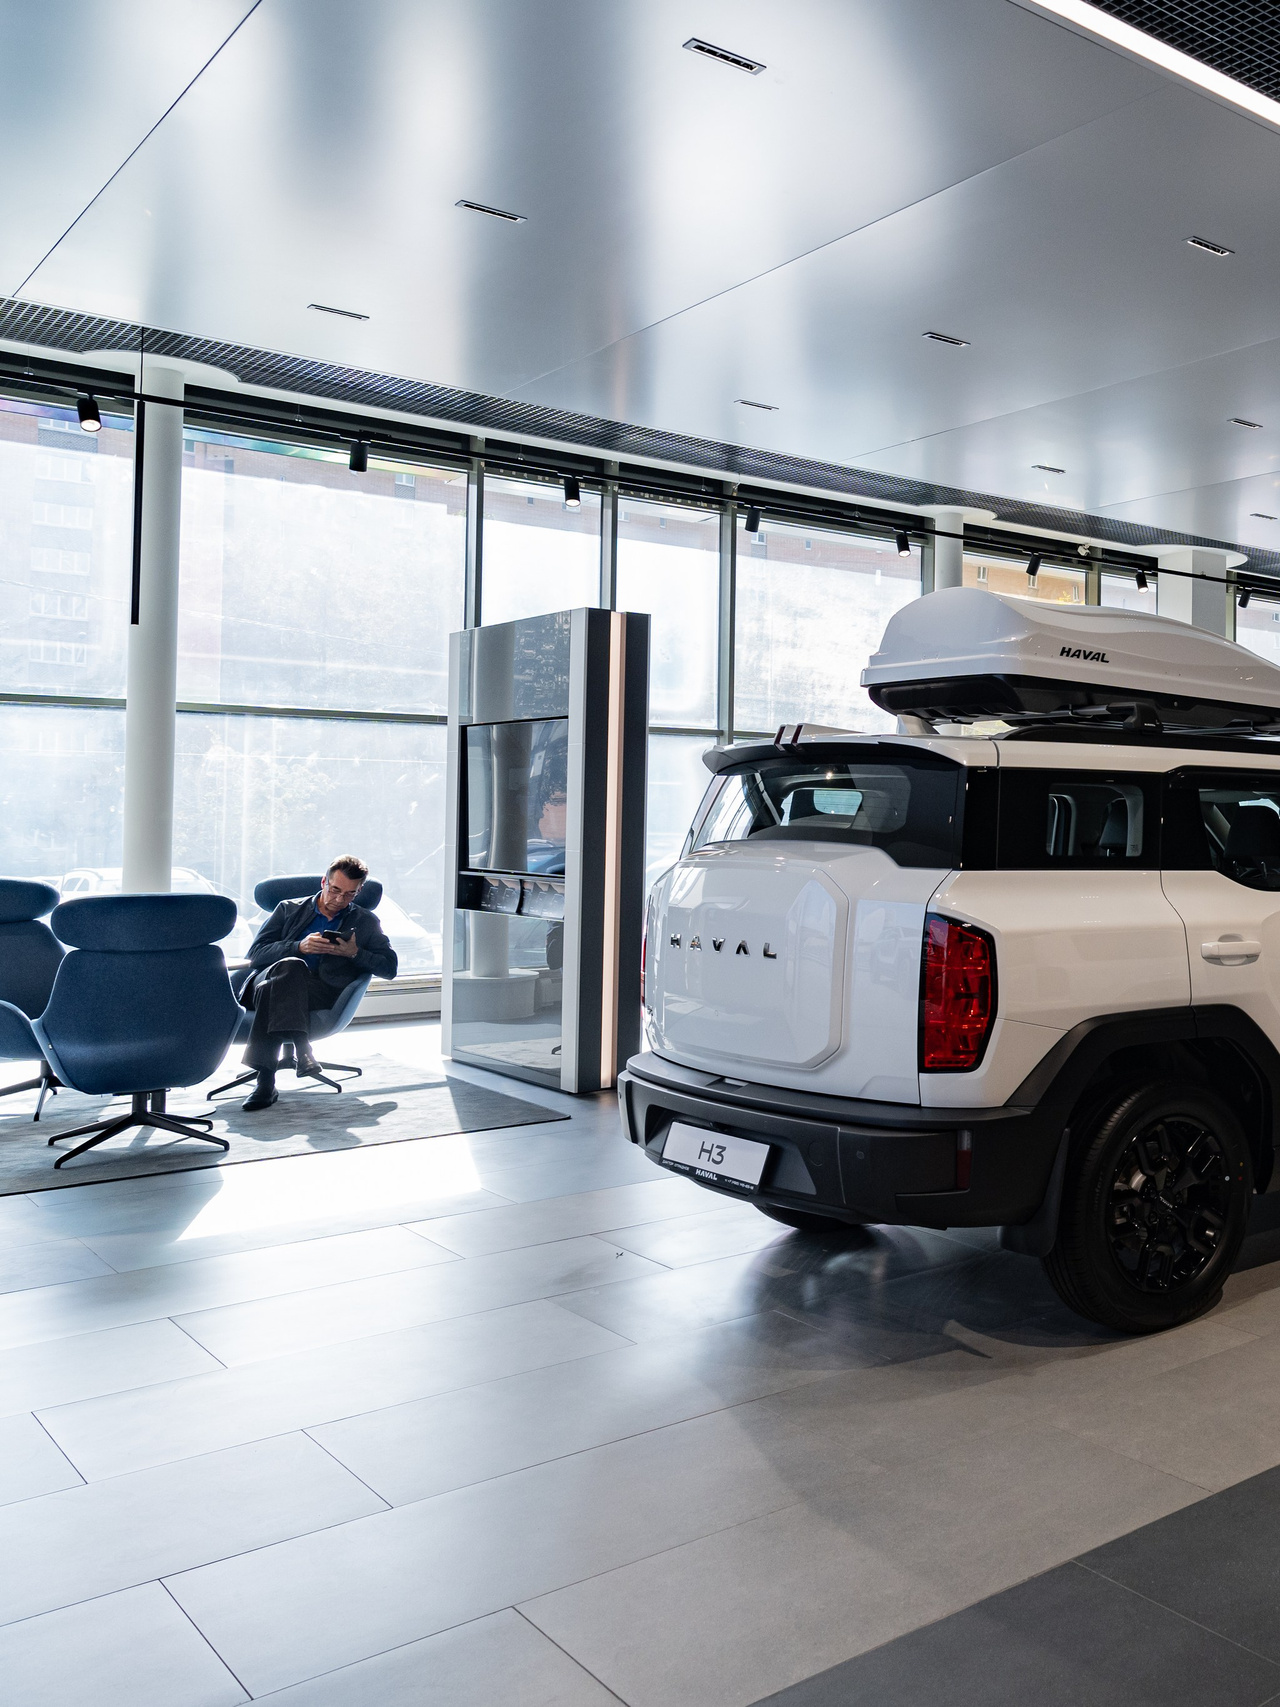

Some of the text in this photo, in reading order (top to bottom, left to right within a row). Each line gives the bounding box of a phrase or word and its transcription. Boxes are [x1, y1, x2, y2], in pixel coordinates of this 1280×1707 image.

[1059, 646, 1110, 664] HAVAL
[670, 933, 777, 959] HAVAL
[697, 1141, 727, 1165] H3
[695, 1169, 718, 1181] HAVAL
